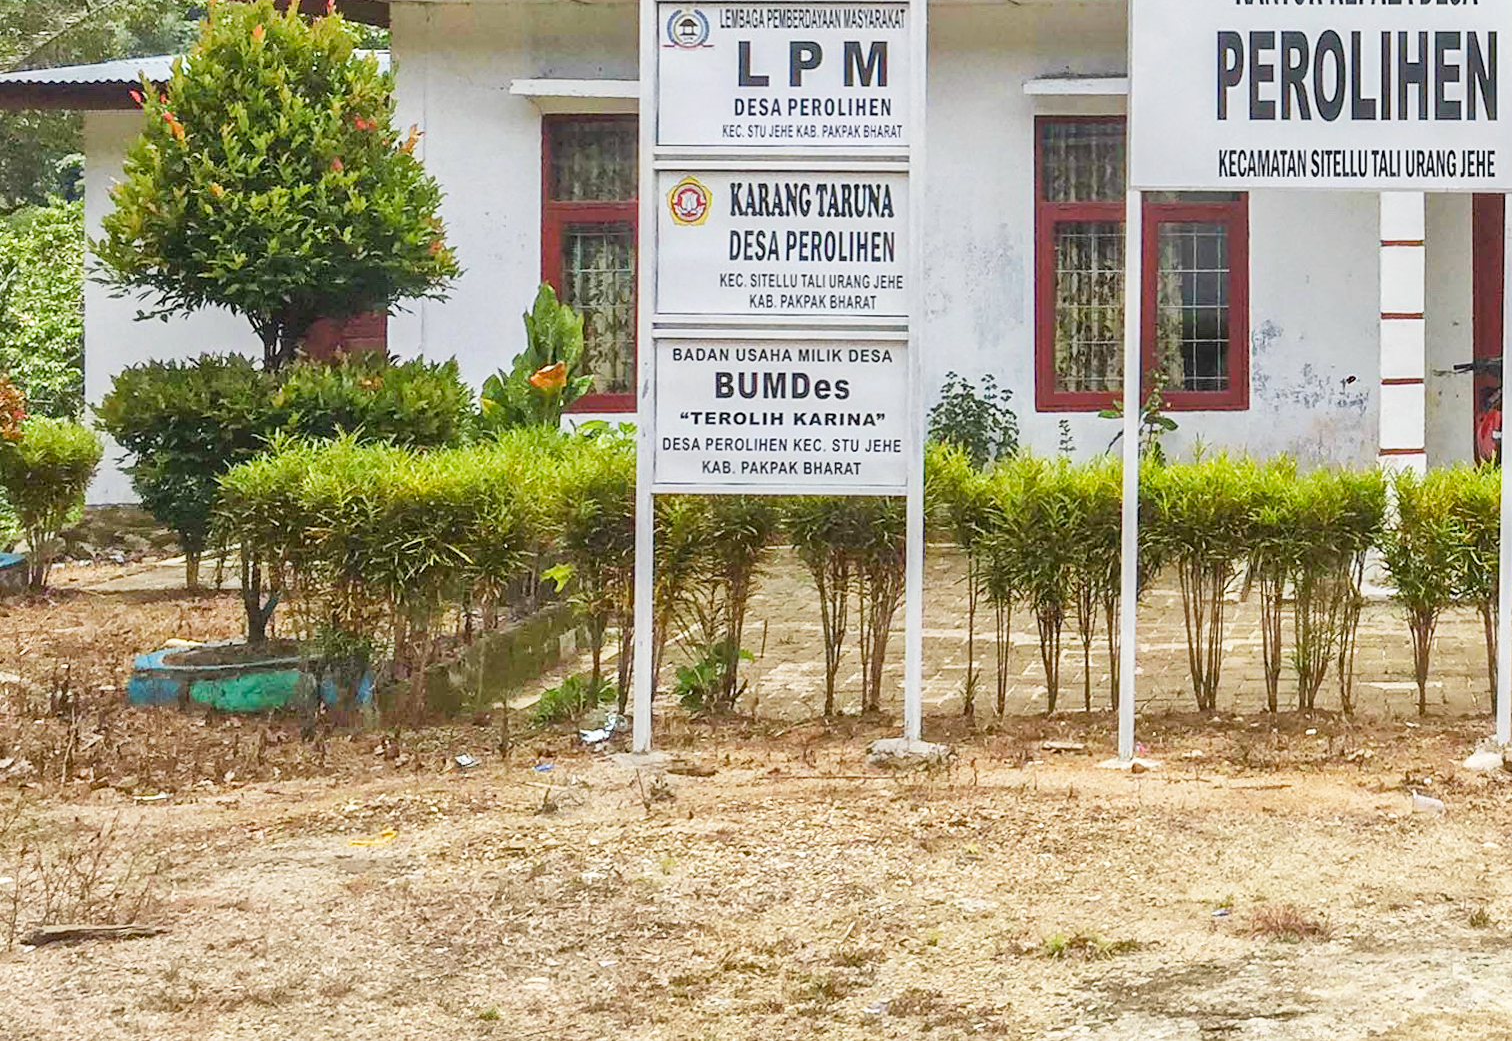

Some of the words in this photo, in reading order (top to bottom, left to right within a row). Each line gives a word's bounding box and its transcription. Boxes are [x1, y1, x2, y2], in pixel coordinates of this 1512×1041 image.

[719, 8, 766, 29] LEMBAGA
[766, 8, 841, 29] PEMBERDAYAAN
[843, 8, 906, 29] MASYARAKAT
[1216, 29, 1498, 122] PEROLIHEN
[734, 97, 782, 117] DESA
[787, 97, 891, 117] PEROLIHEN
[722, 124, 746, 138] KEC.
[747, 124, 766, 138] STU
[768, 124, 794, 138] JEHE
[796, 124, 821, 138] KAB.
[822, 124, 861, 138] PAKPAK
[863, 124, 903, 138] BHARAT
[1218, 149, 1307, 178] KECAMATAN
[1310, 149, 1368, 178] SITELLU
[1370, 149, 1401, 178] TALI
[1405, 149, 1457, 178] URANG
[1459, 149, 1496, 178] JEHE
[729, 182, 812, 218] KARANG
[815, 183, 895, 219] TARUNA
[729, 229, 780, 262] DESA
[785, 230, 895, 263] PEROLIHEN
[719, 273, 748, 288] KEC.
[750, 273, 798, 289] SITELLU
[800, 273, 826, 289] TALI
[829, 274, 870, 289] URANG
[873, 274, 904, 290] JEHE
[749, 293, 777, 309] KAB.
[780, 294, 827, 309] PAKPAK
[829, 294, 877, 310] BHARAT
[672, 347, 730, 362] BADAN
[735, 348, 793, 362] USAHA
[798, 348, 843, 363] MILIK
[848, 348, 893, 363] DESA
[715, 371, 850, 400] BUMDes
[662, 437, 701, 452] DESA
[705, 437, 788, 452] PEROLIHEN
[793, 438, 826, 452] KEC.
[831, 438, 859, 453] STU
[864, 439, 902, 453] JEHE
[702, 460, 735, 475] KAB.
[741, 460, 798, 475] PAKPAK
[803, 461, 862, 476] BHARAT
